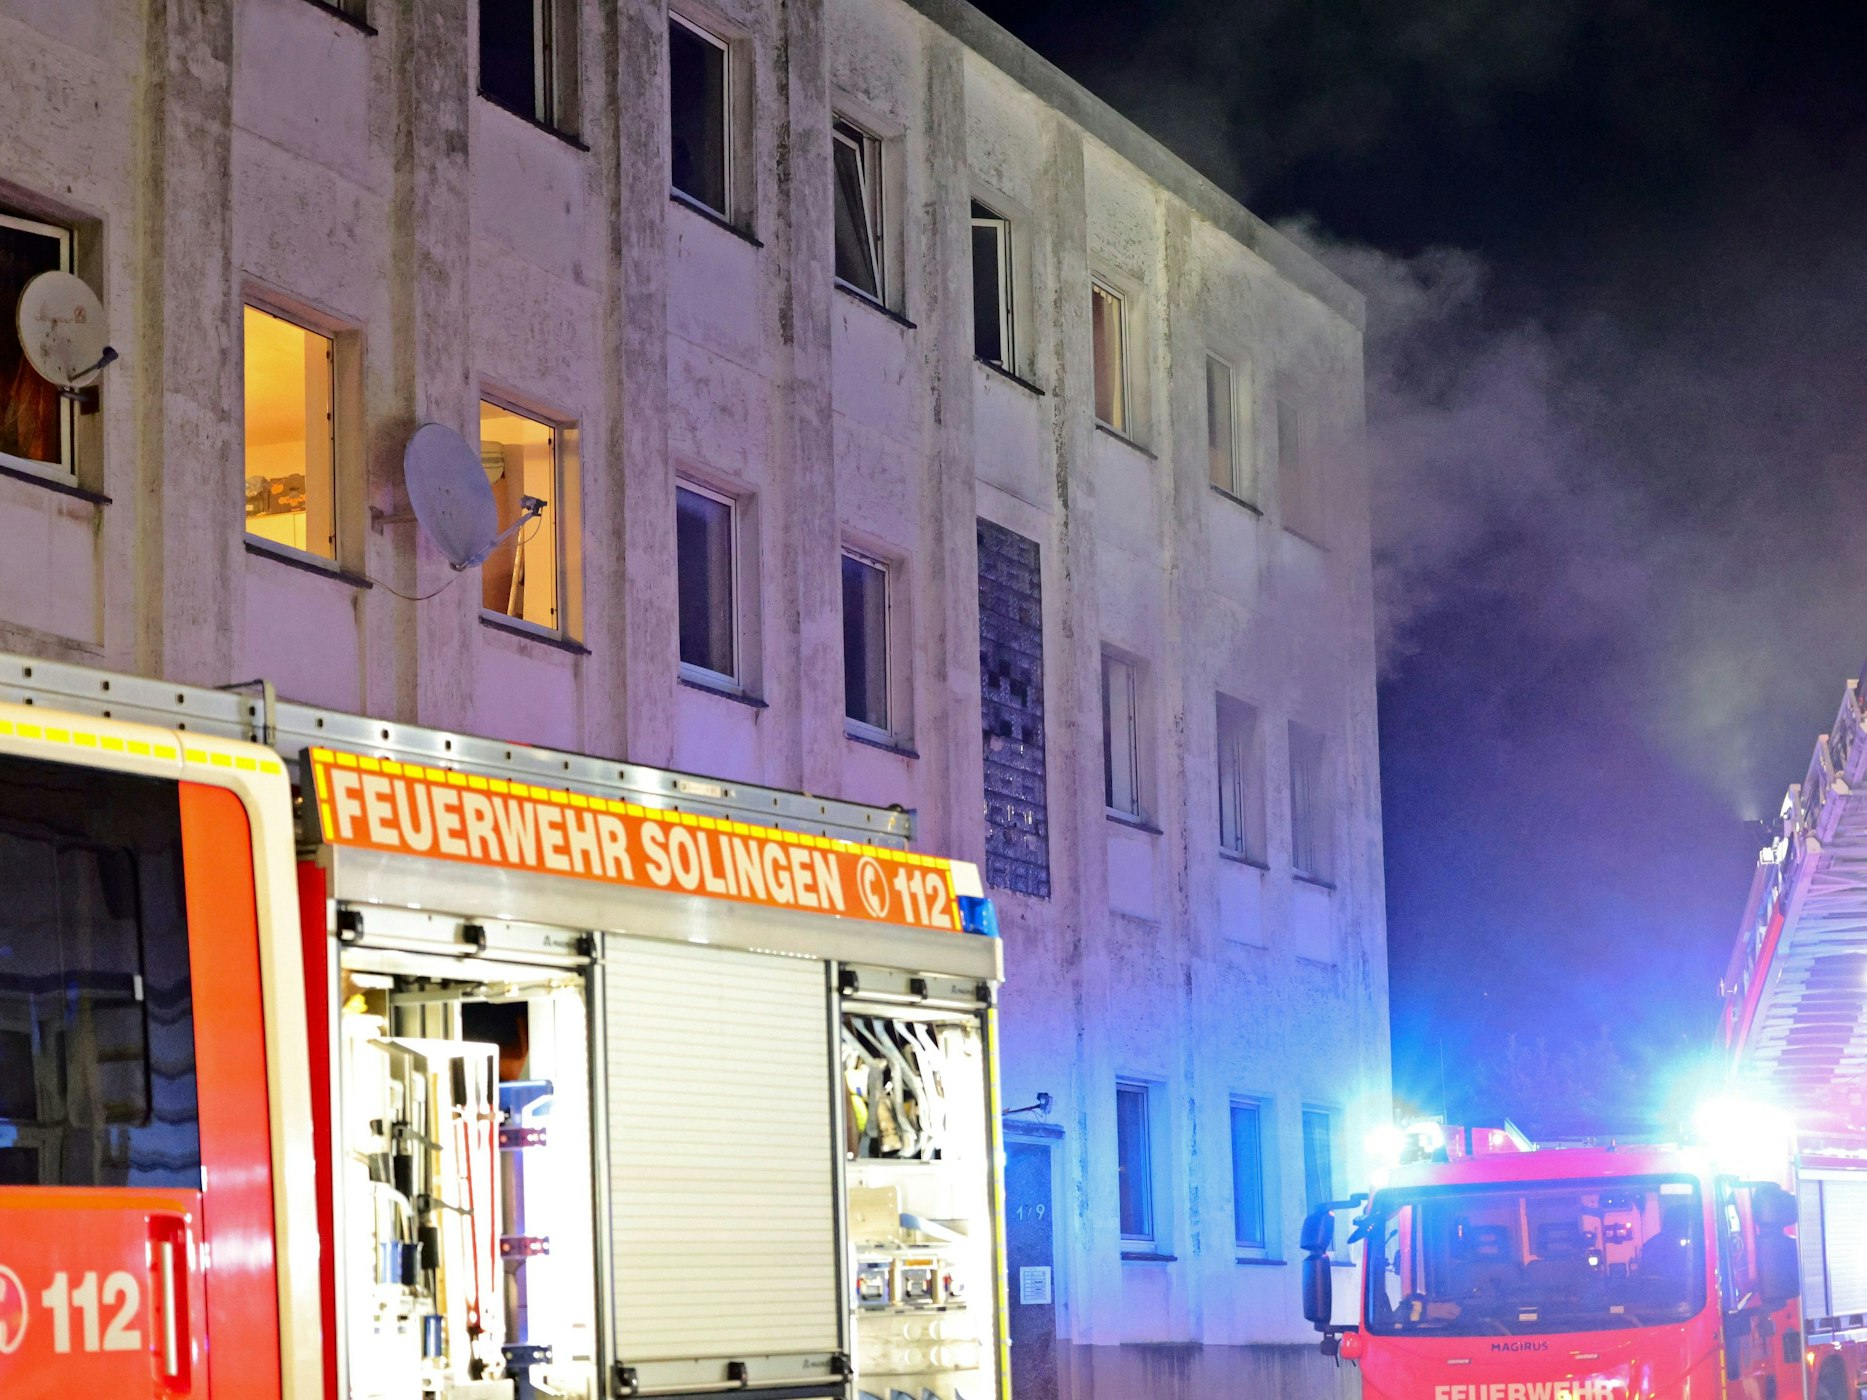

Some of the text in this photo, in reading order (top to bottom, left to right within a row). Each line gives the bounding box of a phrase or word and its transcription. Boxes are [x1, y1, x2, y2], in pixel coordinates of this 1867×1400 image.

[330, 768, 953, 929] FEUERWEHR SOLINGEN 112
[41, 1270, 143, 1354] 112
[1491, 1341, 1549, 1352] MAGIRUS
[1434, 1379, 1615, 1400] FEUERWEHR
